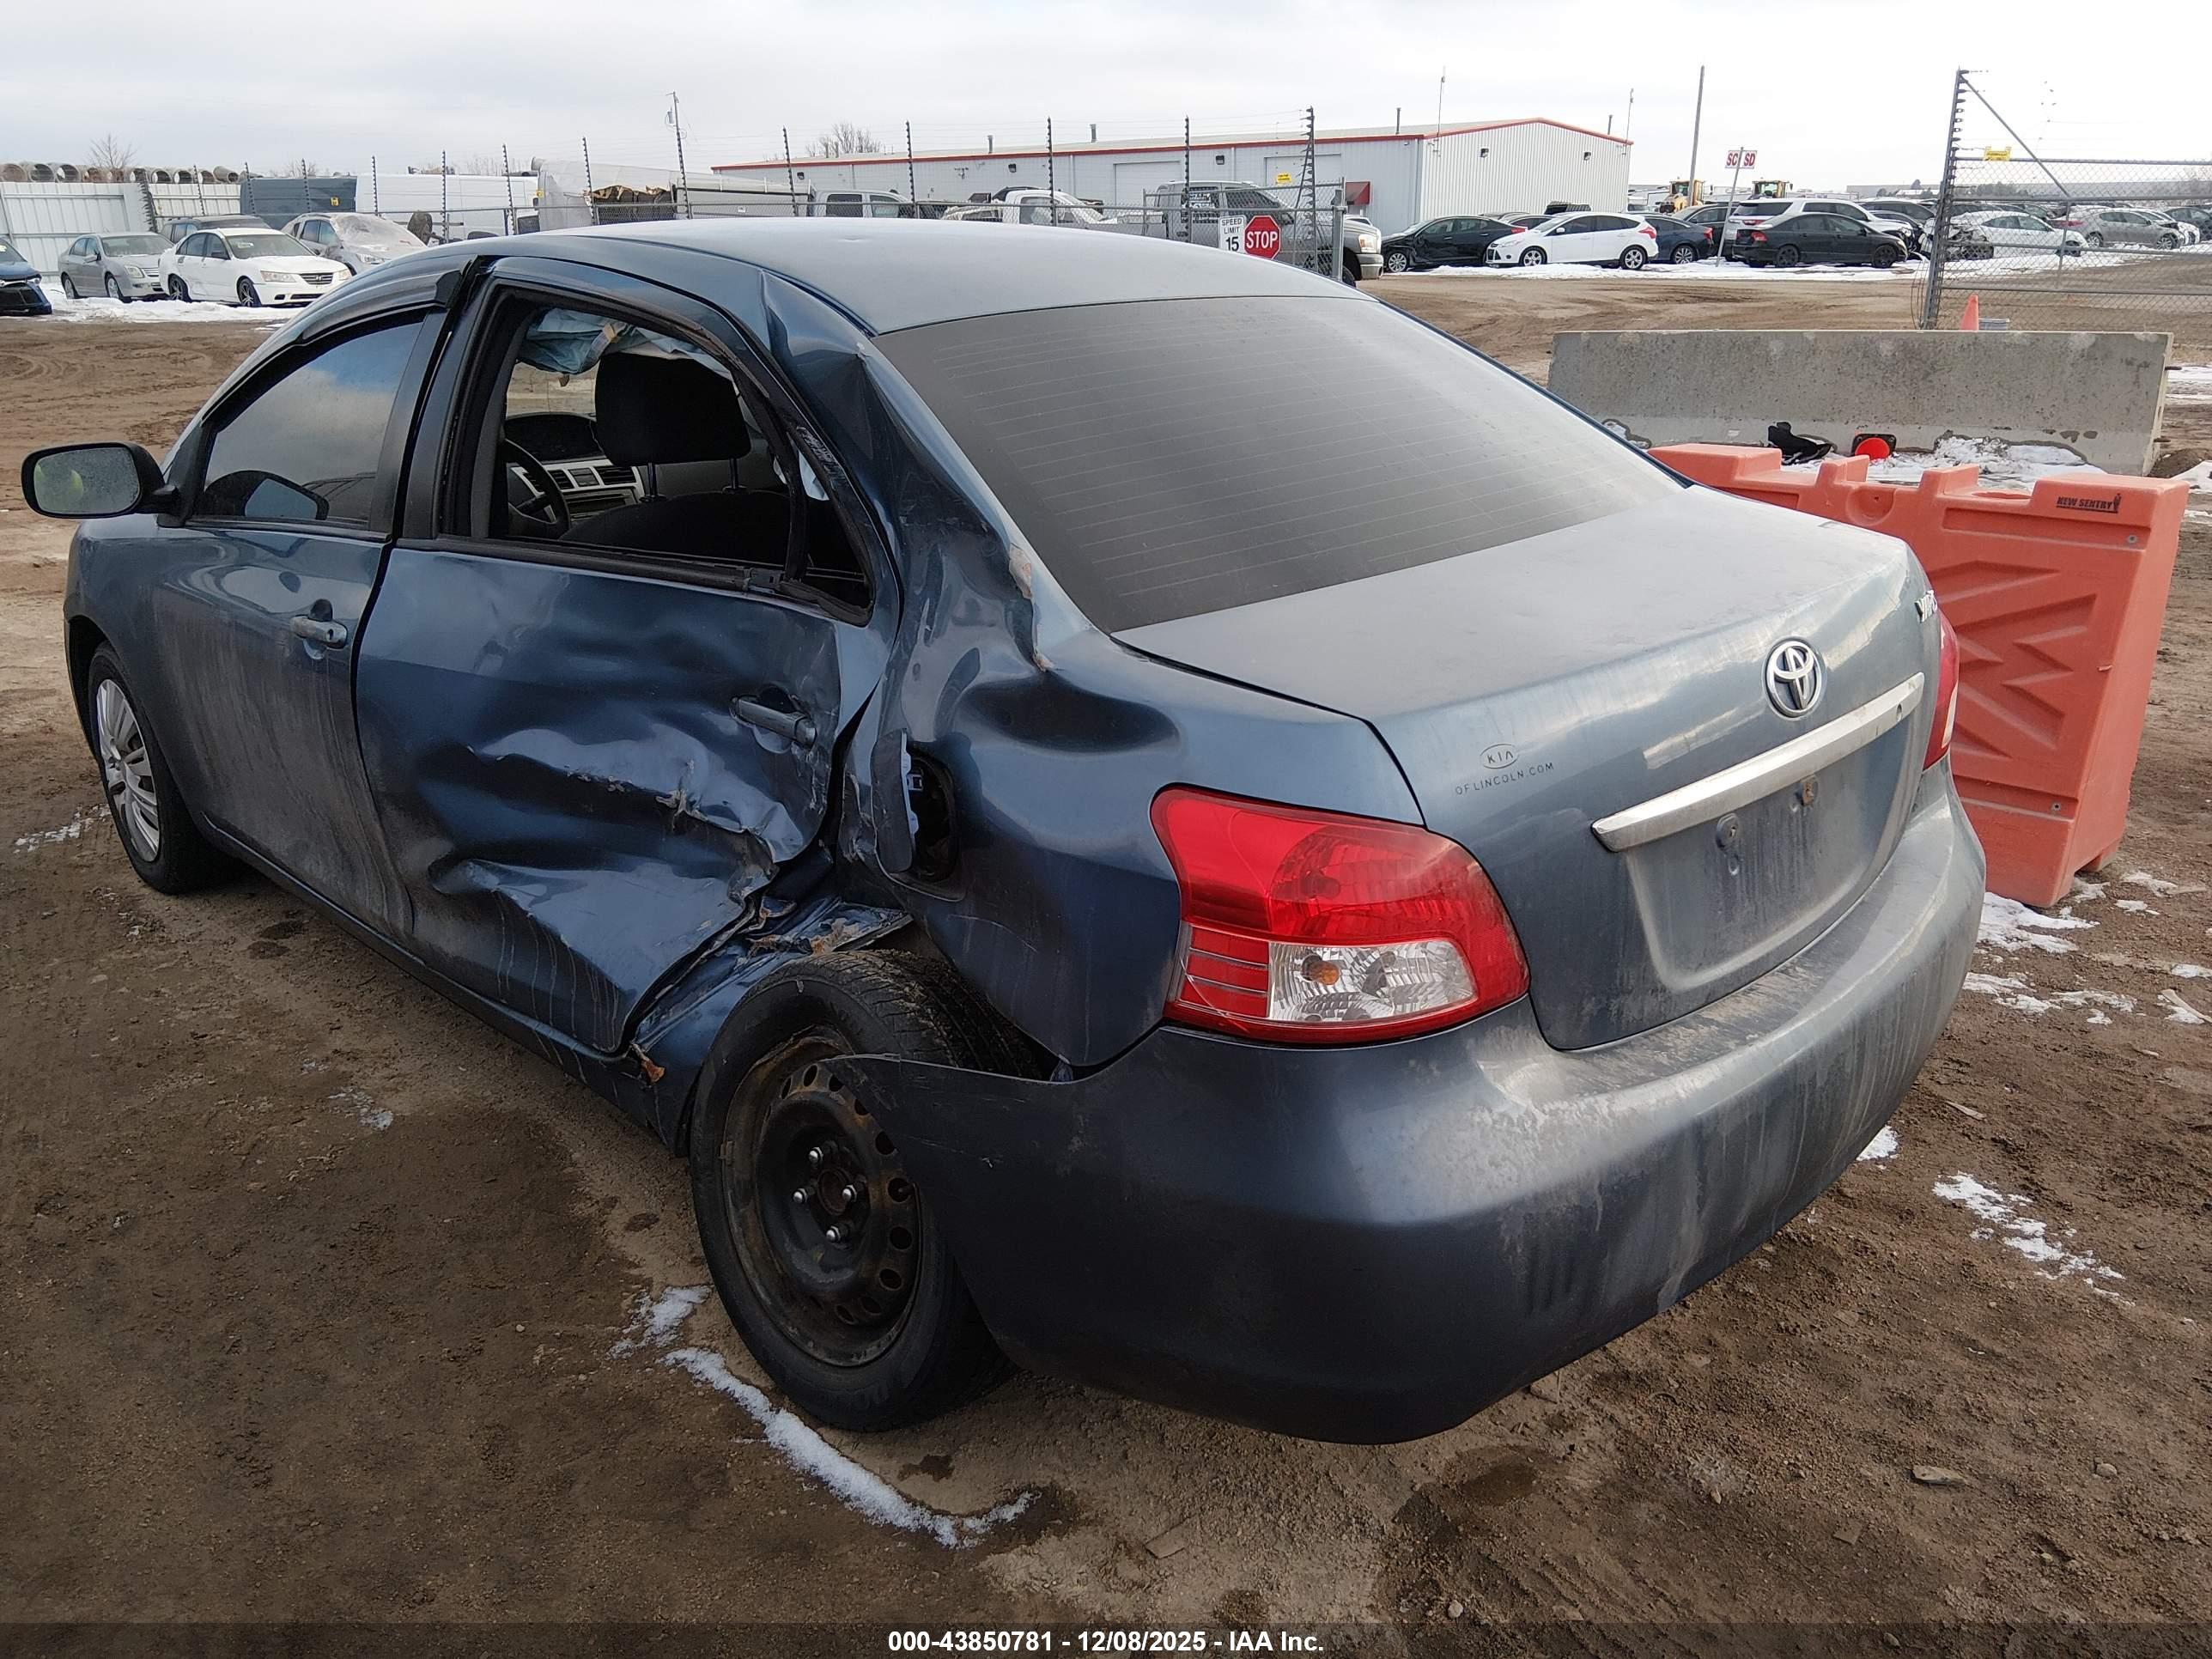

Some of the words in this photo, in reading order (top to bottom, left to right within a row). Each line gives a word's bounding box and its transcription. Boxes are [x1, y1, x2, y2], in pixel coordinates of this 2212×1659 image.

[1726, 152, 1739, 167] SC
[1743, 152, 1756, 167] SD
[1221, 217, 1243, 227] SPEED
[1224, 226, 1241, 234] LIMIT
[1225, 236, 1240, 252] 15
[1246, 230, 1279, 249] STOP
[2057, 495, 2078, 506] NEW
[2078, 498, 2113, 510] SENTRY
[1486, 750, 1514, 764] KIA
[1455, 783, 1471, 795] OF
[1473, 762, 1555, 792] LINCOLN.COM
